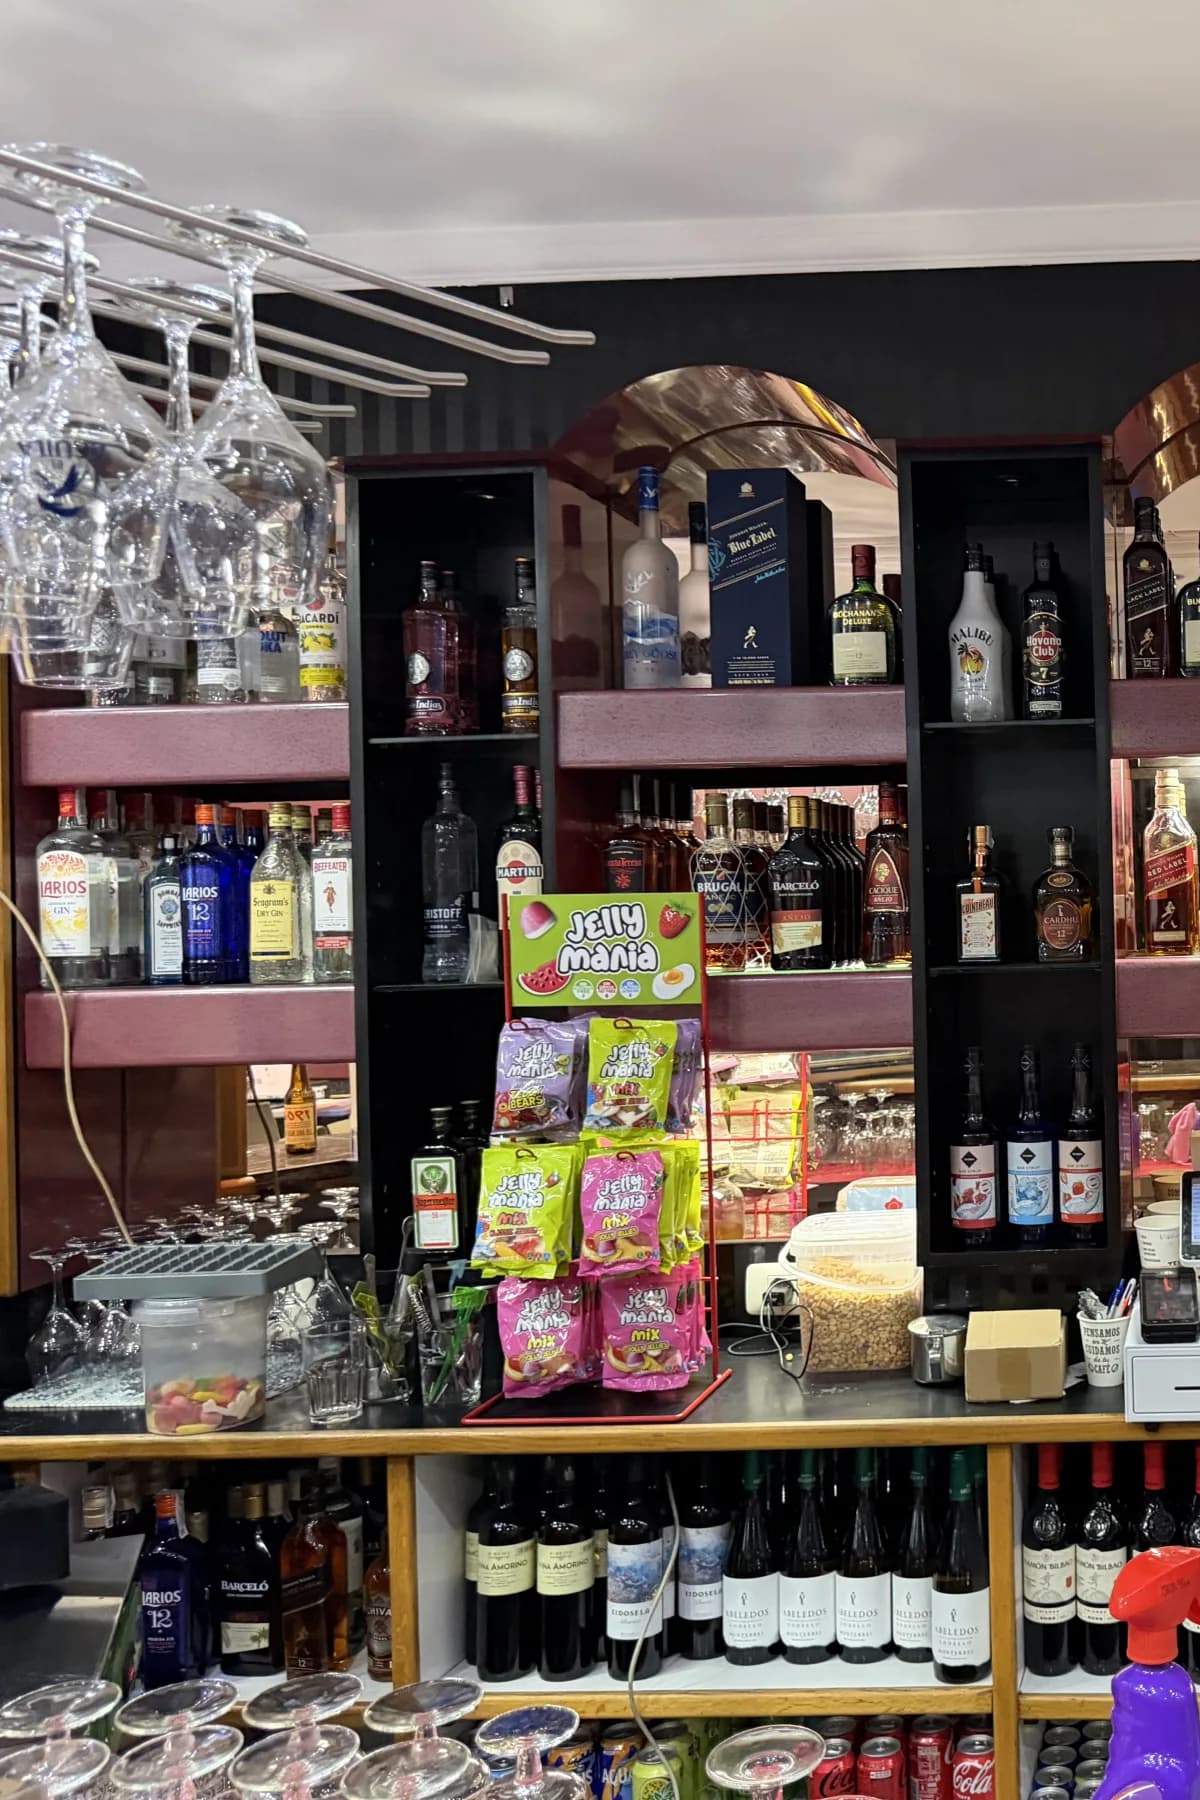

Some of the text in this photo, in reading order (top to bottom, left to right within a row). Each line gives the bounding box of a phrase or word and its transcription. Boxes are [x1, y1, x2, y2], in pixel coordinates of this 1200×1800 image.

[728, 528, 777, 555] Blue Label
[1127, 592, 1145, 604] LACK
[951, 626, 994, 647] MALIBU
[1026, 635, 1062, 647] Havana
[1032, 646, 1056, 657] Club
[1039, 667, 1048, 679] 7
[314, 861, 347, 873] BEEFEATER
[498, 866, 541, 877] MARTINI
[1148, 858, 1187, 877] RED LABEL
[40, 881, 87, 898] LARIOS
[697, 882, 742, 892] BRUGAL
[773, 880, 819, 891] BARCELÓ
[868, 886, 899, 895] CACIQUE
[182, 887, 217, 901] LARIOS
[53, 906, 70, 914] GIN
[187, 903, 209, 920] 12
[962, 898, 994, 914] COINTREAU
[1043, 916, 1079, 925] CARDHU
[1056, 930, 1066, 938] 12
[509, 1096, 545, 1110] BEARS
[1083, 1326, 1120, 1337] PENSAMOS
[221, 1580, 269, 1592] BARCELÓ
[142, 1590, 182, 1607] LARIOS
[367, 1607, 392, 1616] CHIVA
[147, 1608, 173, 1629] 12
[601, 1768, 633, 1785] AQUA
